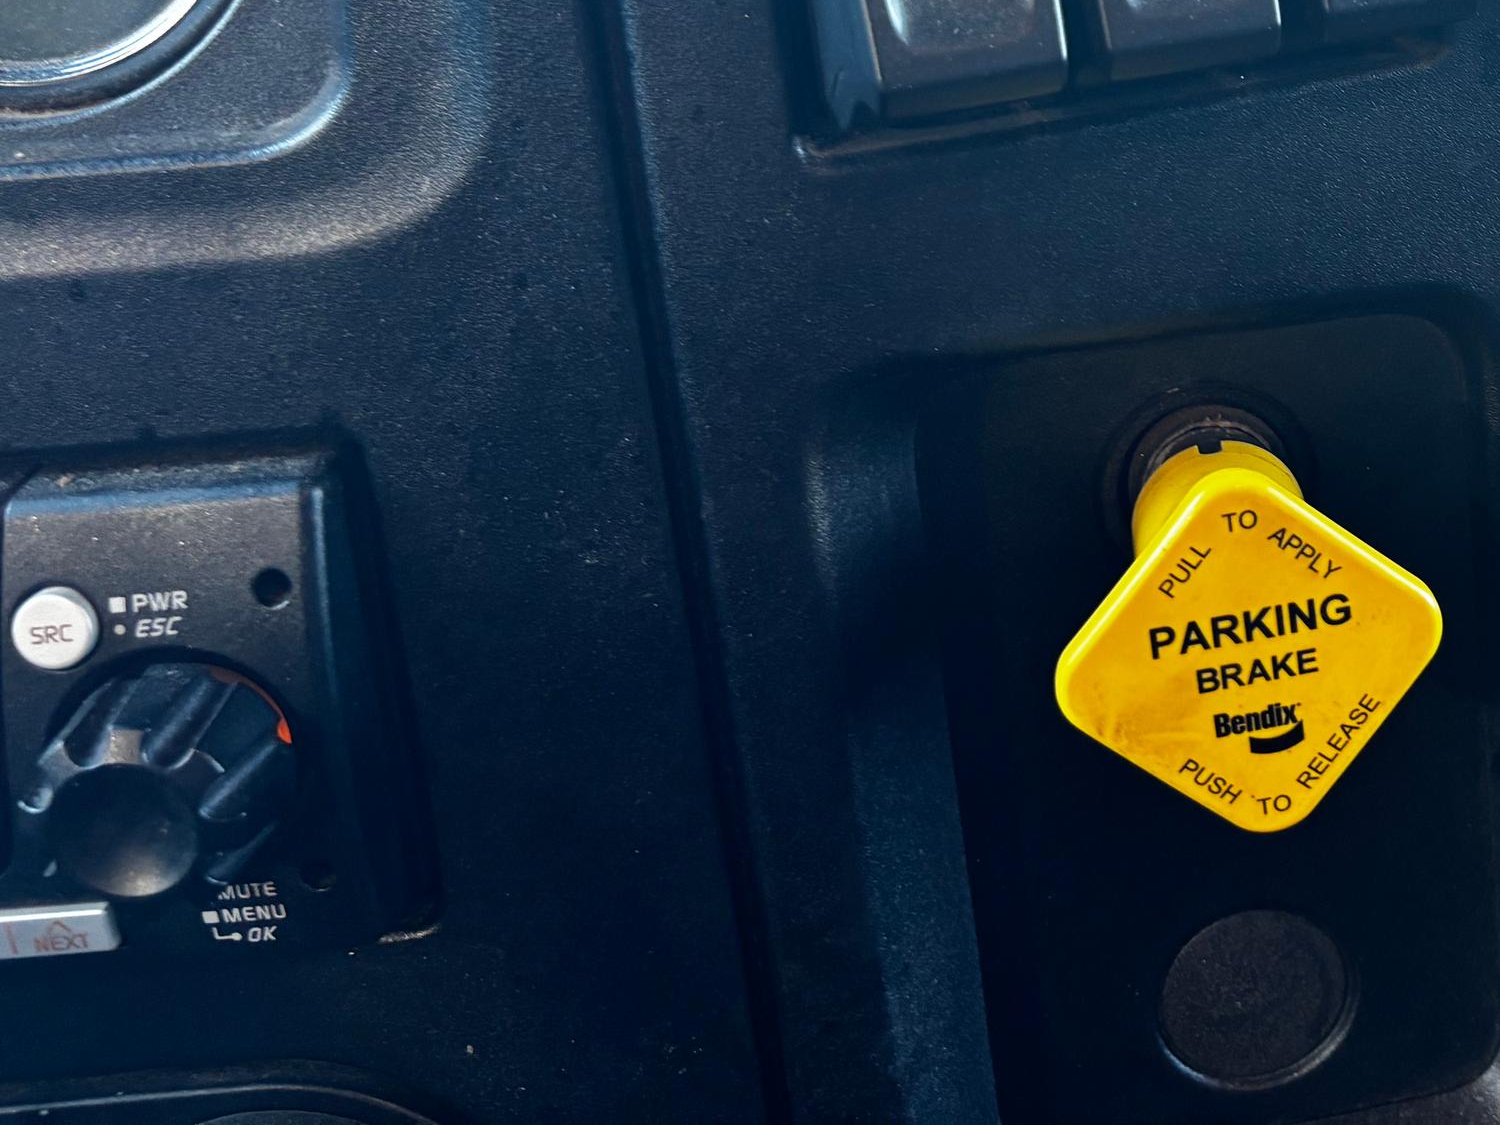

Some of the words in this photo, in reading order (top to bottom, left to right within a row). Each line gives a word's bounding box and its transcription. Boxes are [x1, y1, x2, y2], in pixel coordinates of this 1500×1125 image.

[1158, 543, 1212, 599] PULL
[1221, 509, 1259, 533] TO
[1267, 527, 1343, 580] APPLY
[131, 591, 188, 613] PWR
[30, 623, 74, 645] SRC
[134, 616, 182, 637] ESC
[1148, 592, 1353, 660] PARKING
[1195, 647, 1319, 694] BRAKE
[1213, 702, 1298, 738] Bendix
[1178, 758, 1242, 805] PUSH
[1256, 793, 1292, 815] TO
[1296, 693, 1381, 789] RELEASE
[217, 881, 278, 900] MUTE
[221, 904, 287, 923] MENU
[33, 932, 90, 953] NEXT
[247, 926, 277, 942] OK
